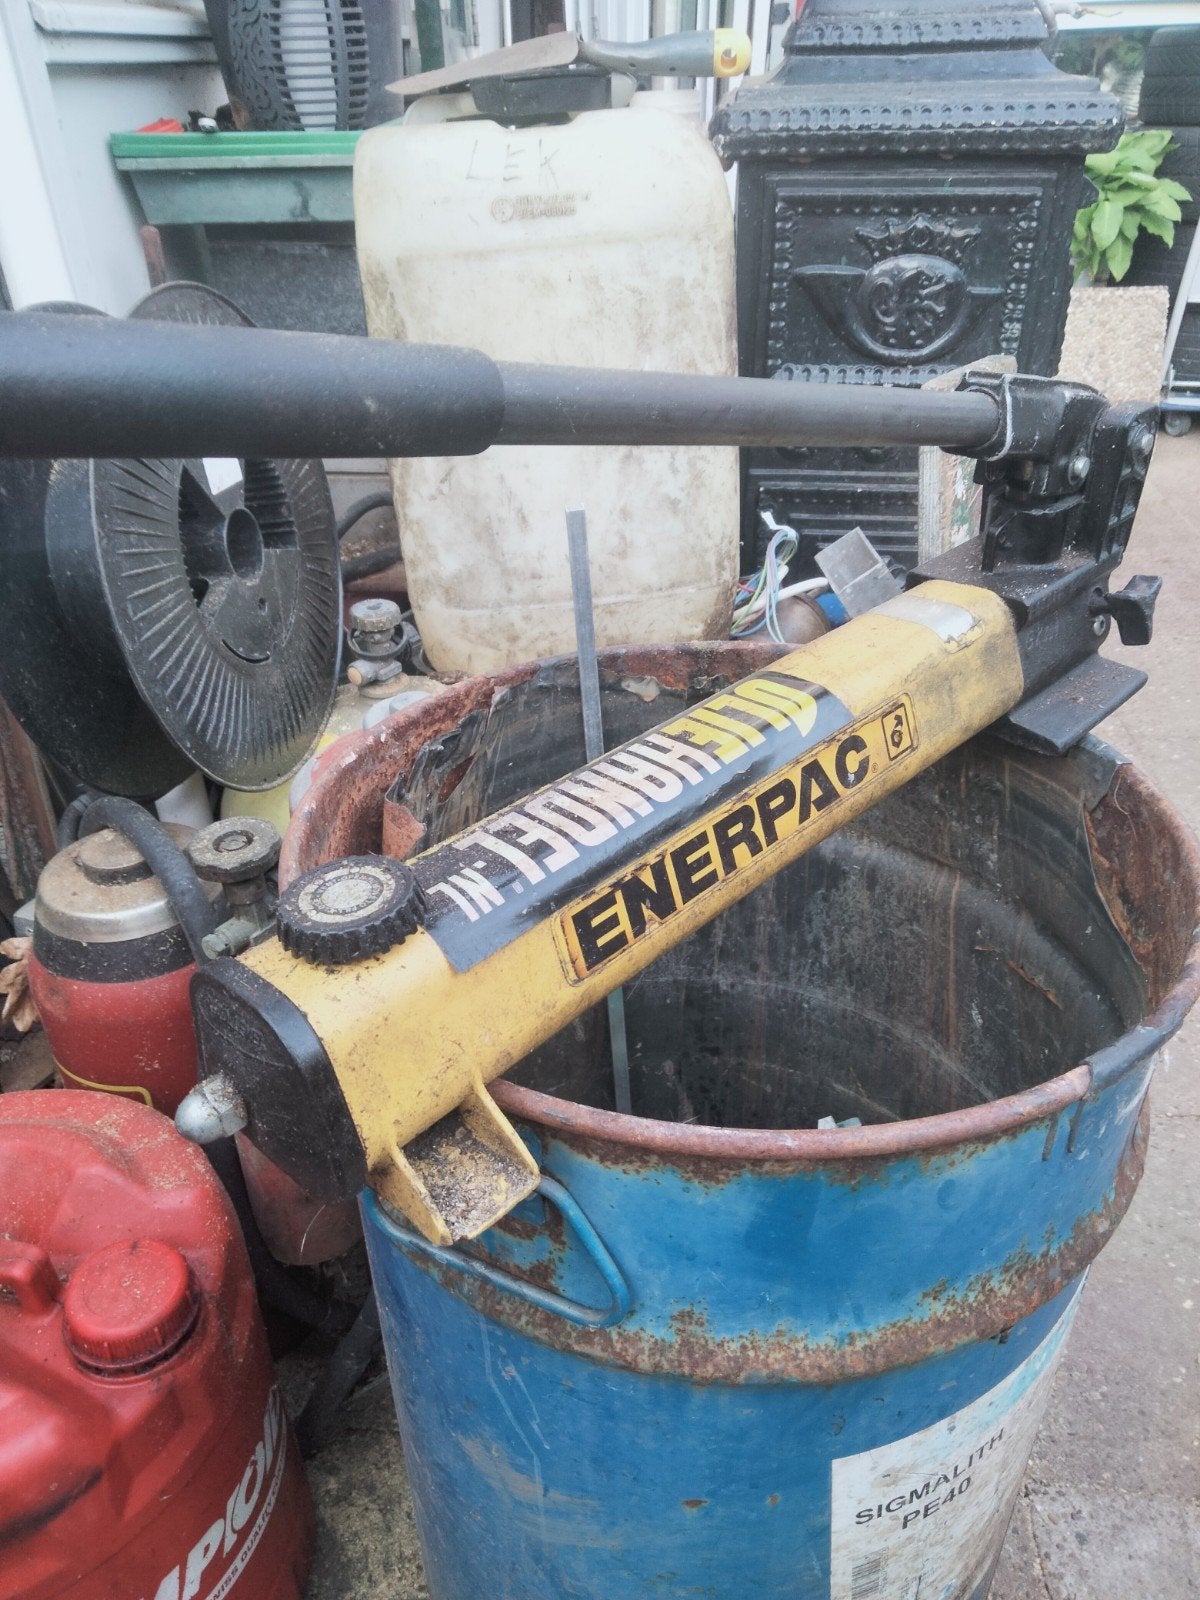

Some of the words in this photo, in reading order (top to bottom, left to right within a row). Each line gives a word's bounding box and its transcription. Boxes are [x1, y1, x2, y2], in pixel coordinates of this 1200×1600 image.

[571, 734, 869, 972] ENERPAC
[855, 1427, 1004, 1525] SIGMALITH
[901, 1476, 972, 1530] PE40
